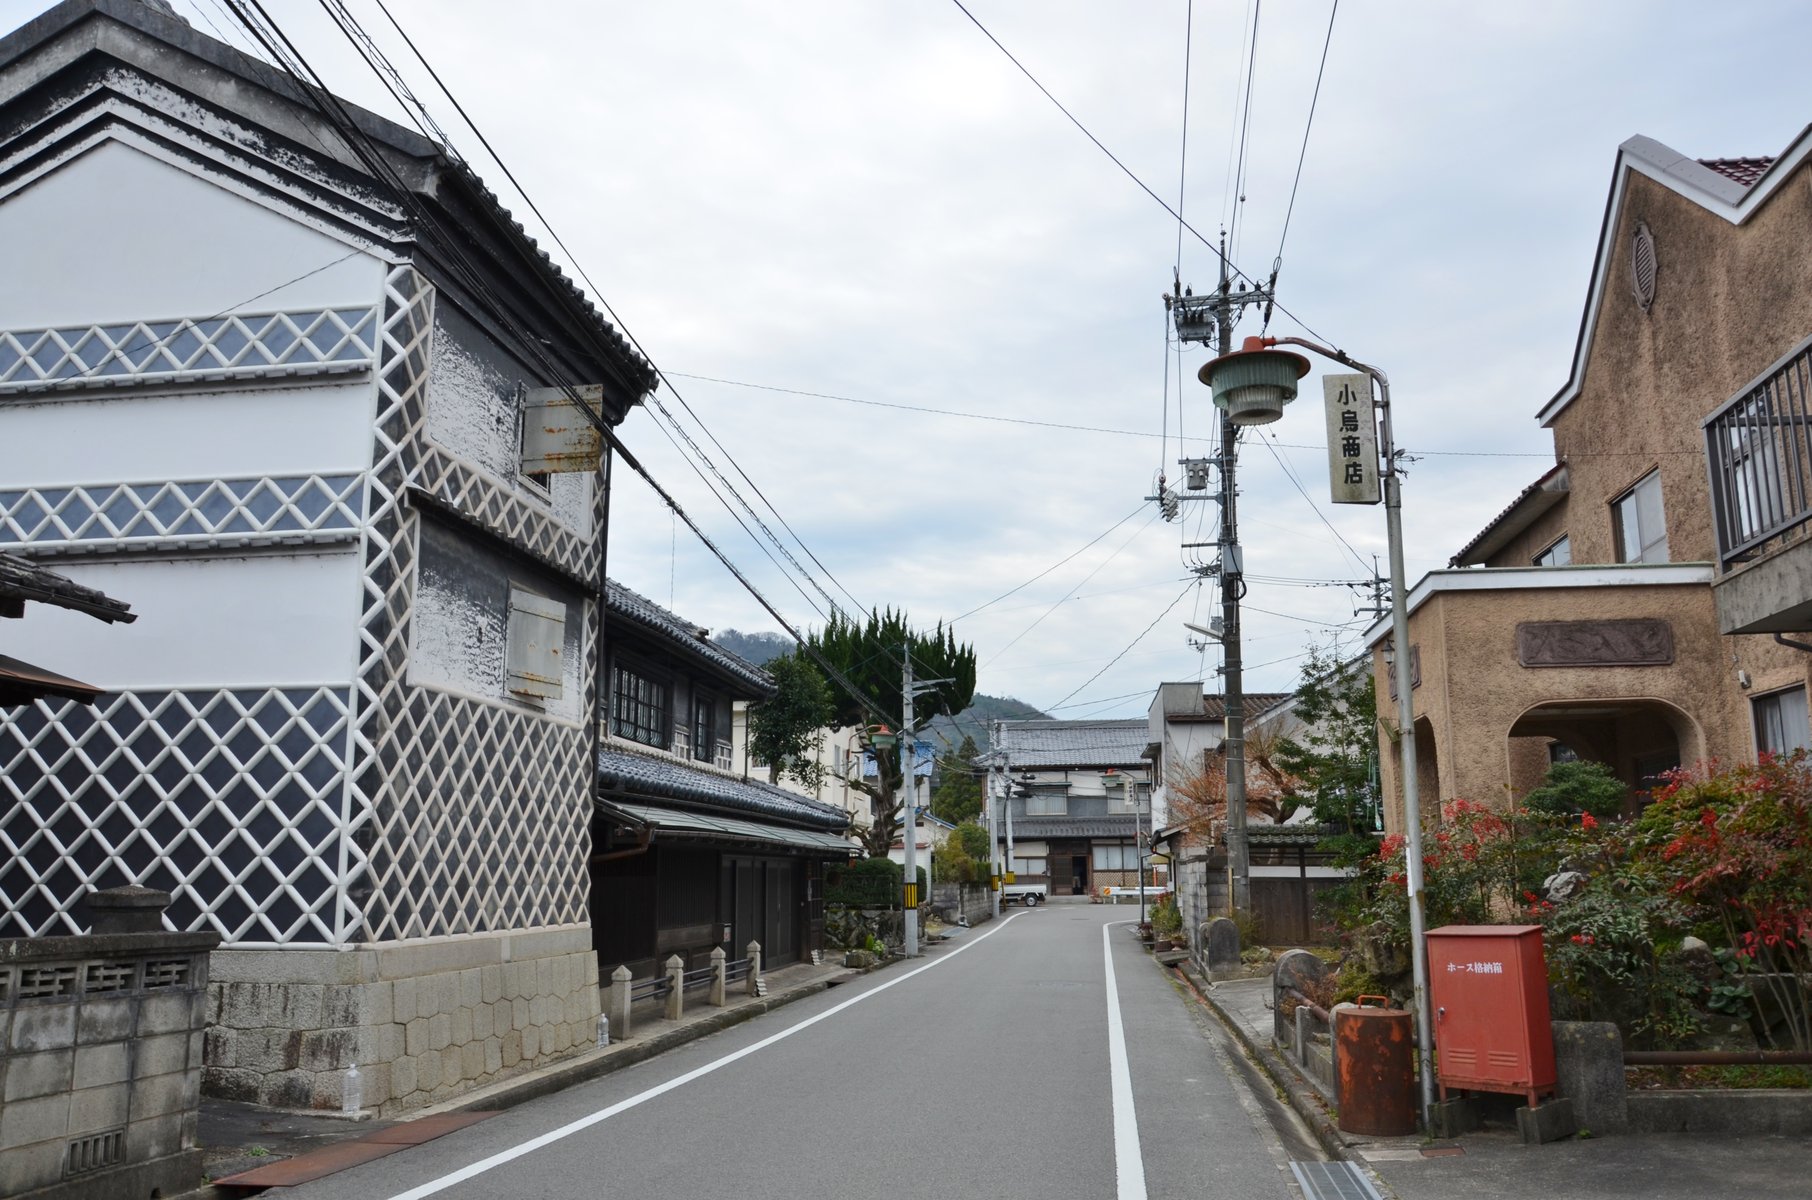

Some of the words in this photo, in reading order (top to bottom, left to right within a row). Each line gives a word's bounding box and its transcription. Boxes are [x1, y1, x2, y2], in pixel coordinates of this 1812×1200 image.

[1447, 961, 1503, 974] ホース格納箱
